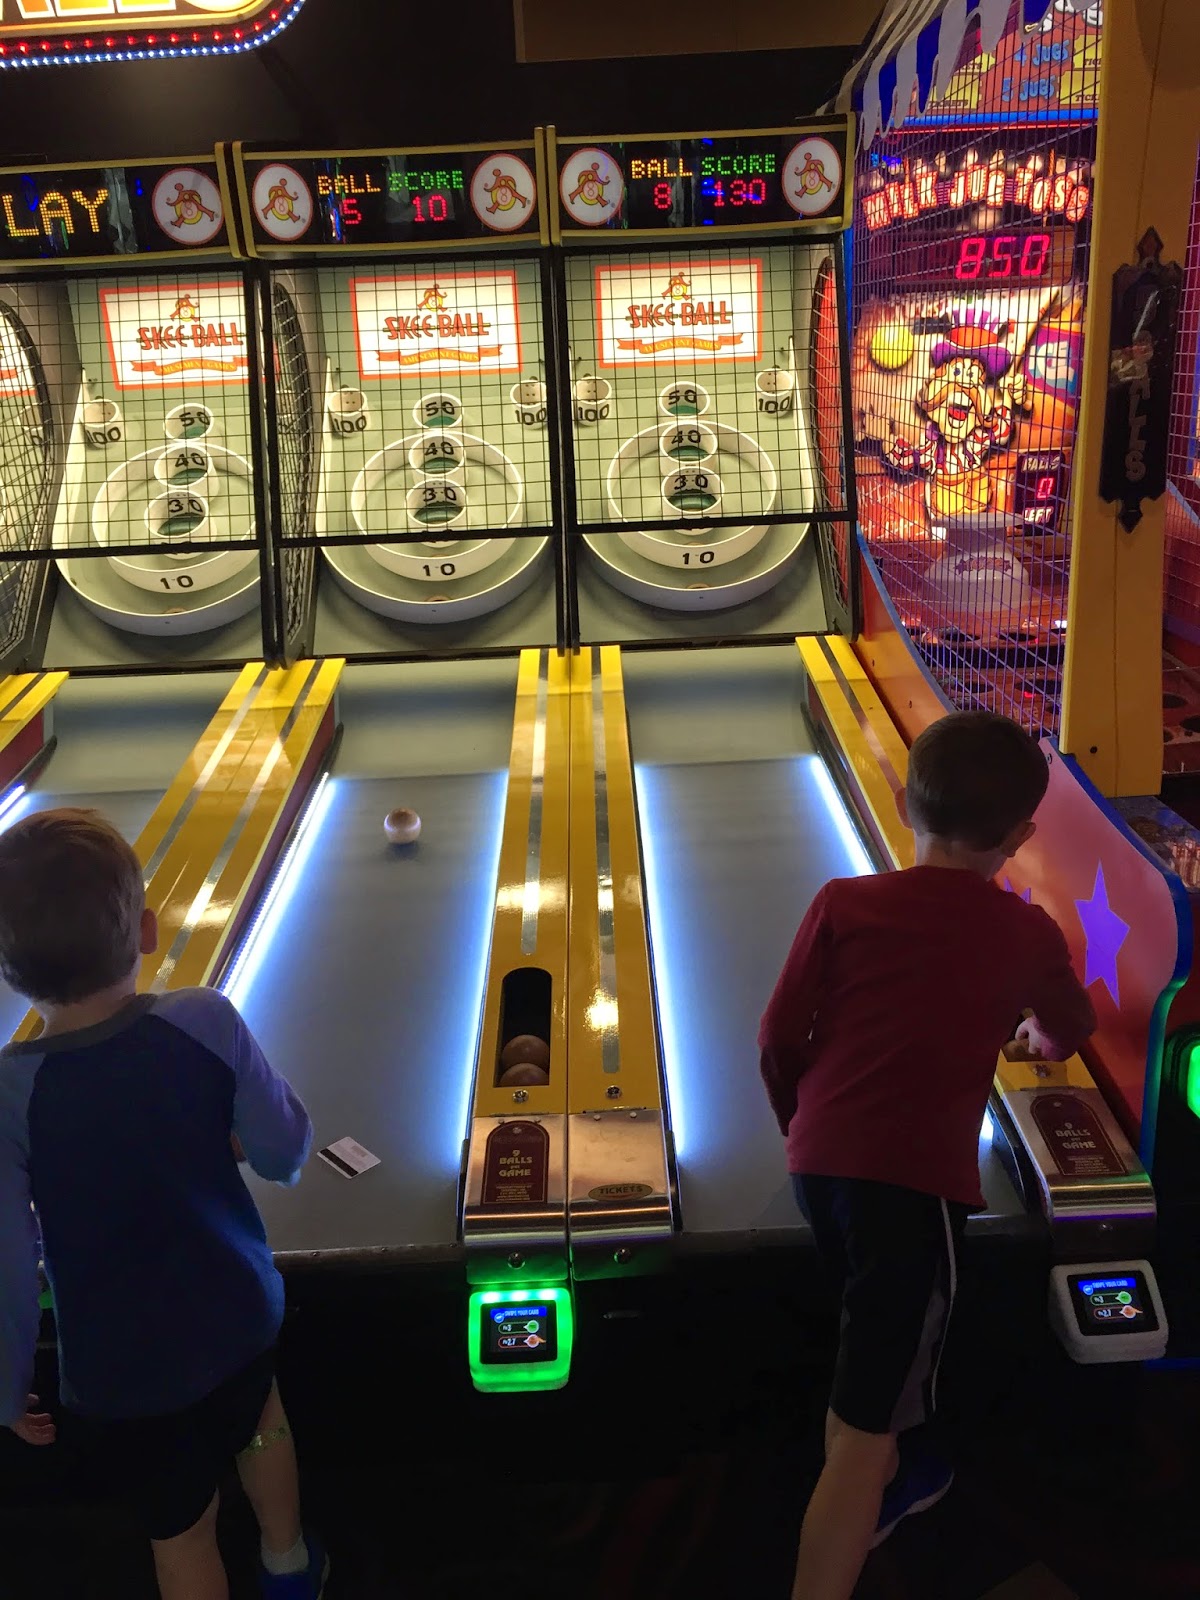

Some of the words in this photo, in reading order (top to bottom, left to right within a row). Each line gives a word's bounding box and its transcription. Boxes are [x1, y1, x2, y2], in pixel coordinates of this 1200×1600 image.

[1032, 40, 1070, 66] JUGS
[1019, 75, 1056, 101] JUGS
[631, 158, 693, 179] BALL
[701, 154, 776, 176] SCORE
[317, 174, 381, 195] BALL
[389, 170, 464, 191] SCORE
[654, 183, 672, 209] 8
[713, 179, 766, 207] 130
[862, 171, 938, 231] MILK
[949, 165, 1006, 209] JUG
[1015, 167, 1089, 223] TOSS
[342, 198, 362, 225] 5
[412, 195, 448, 222] 10
[955, 235, 1050, 279] 850
[668, 390, 698, 405] 50
[758, 396, 792, 414] 100
[425, 401, 456, 416] 50
[578, 404, 610, 422] 100
[179, 411, 211, 427] 50
[333, 415, 368, 433] 100
[515, 408, 548, 426] 100
[85, 426, 122, 445] 100
[671, 430, 701, 445] 40
[424, 441, 455, 456] 40
[175, 452, 206, 468] 40
[1022, 457, 1060, 472] BALLS
[674, 474, 709, 490] 30
[422, 487, 457, 501] 30
[168, 499, 204, 513] 30
[1024, 507, 1054, 522] LEFT
[682, 551, 715, 565] 10
[422, 563, 456, 577] 10
[160, 574, 194, 590] 10
[1055, 1129, 1091, 1137] BALLS
[1062, 1141, 1097, 1149] GAME
[499, 1157, 533, 1165] BALLS
[499, 1169, 531, 1177] GAME
[598, 1186, 643, 1194] TICKETS
